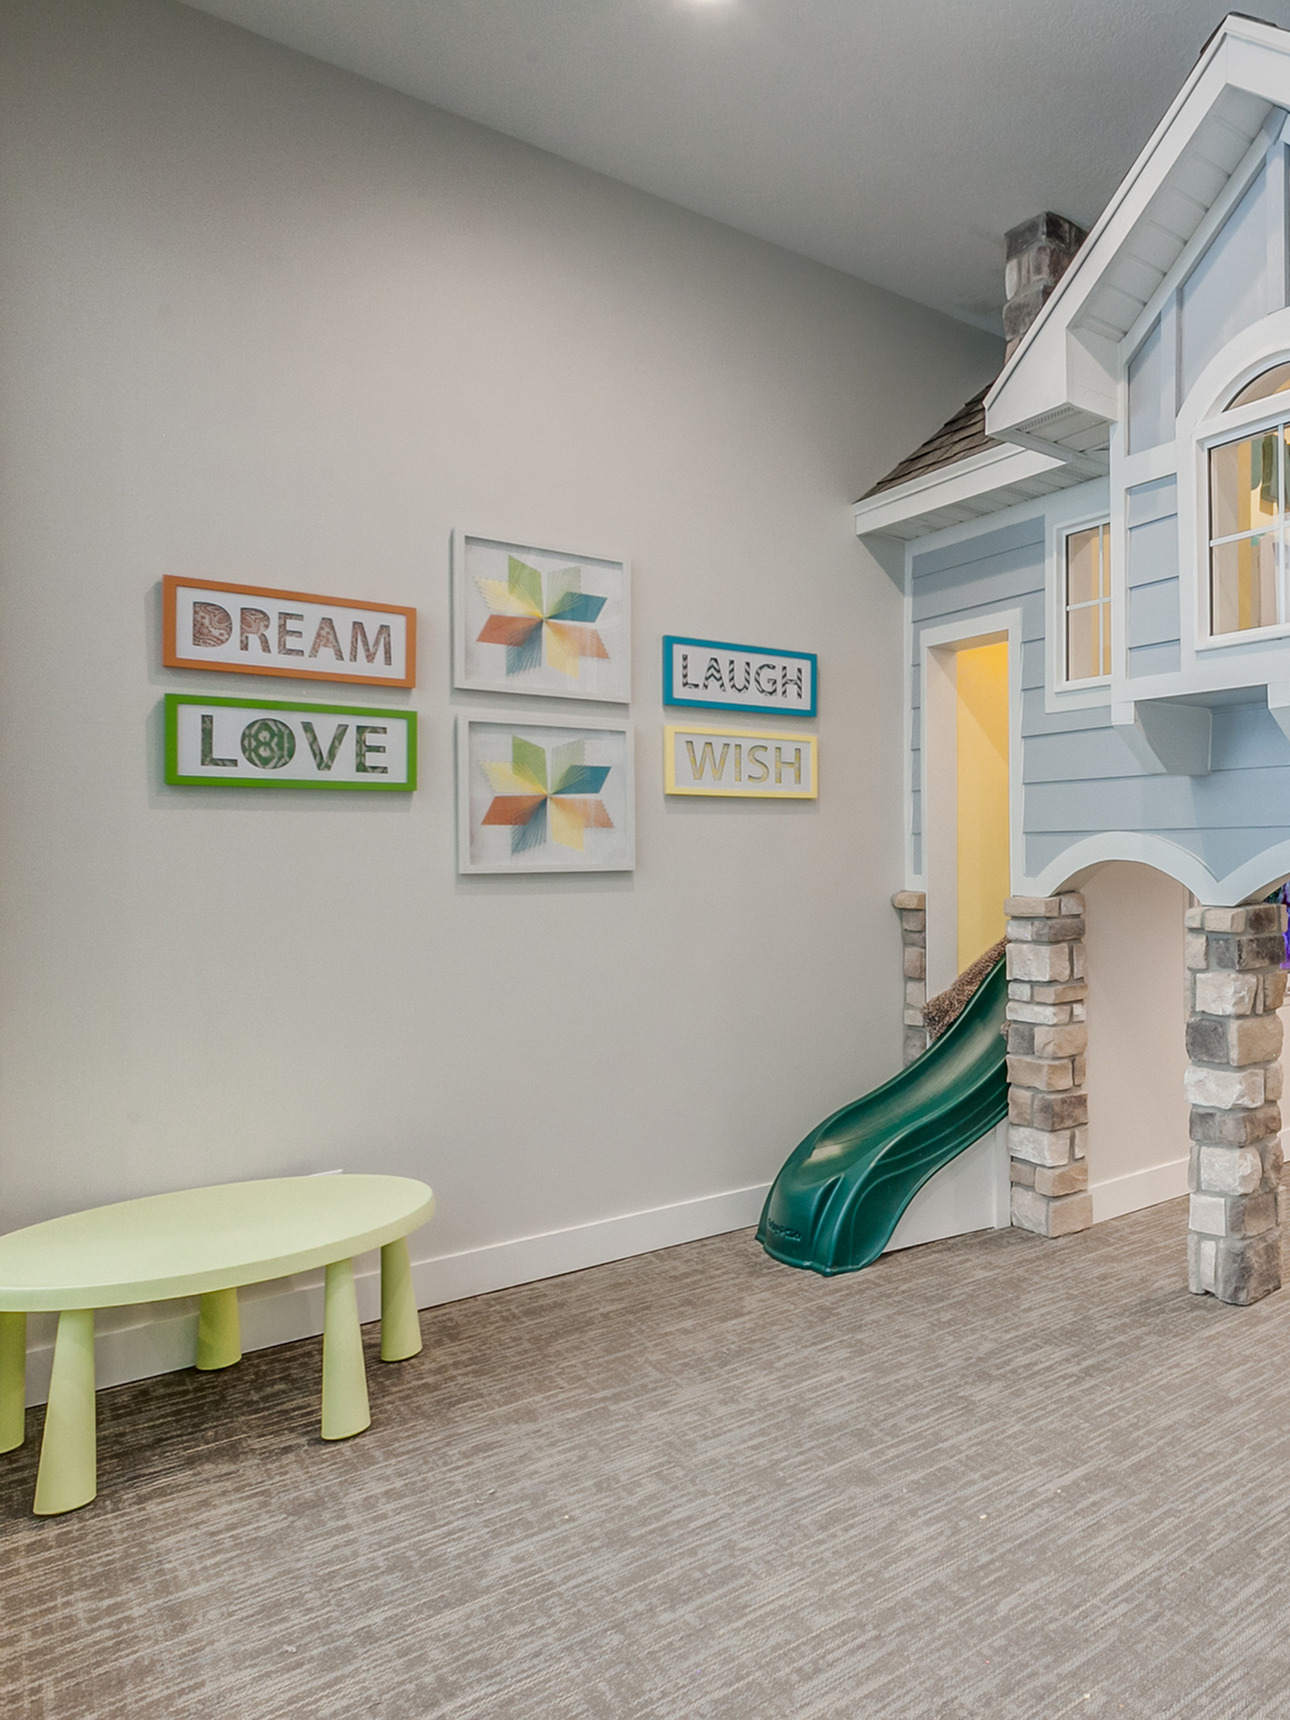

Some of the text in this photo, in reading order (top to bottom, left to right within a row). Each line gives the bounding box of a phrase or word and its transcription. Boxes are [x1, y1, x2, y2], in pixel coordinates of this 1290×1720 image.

[192, 601, 392, 666] DREAM
[682, 654, 803, 699] LAUGH
[201, 714, 389, 774] LOVE
[685, 740, 802, 785] WISH
